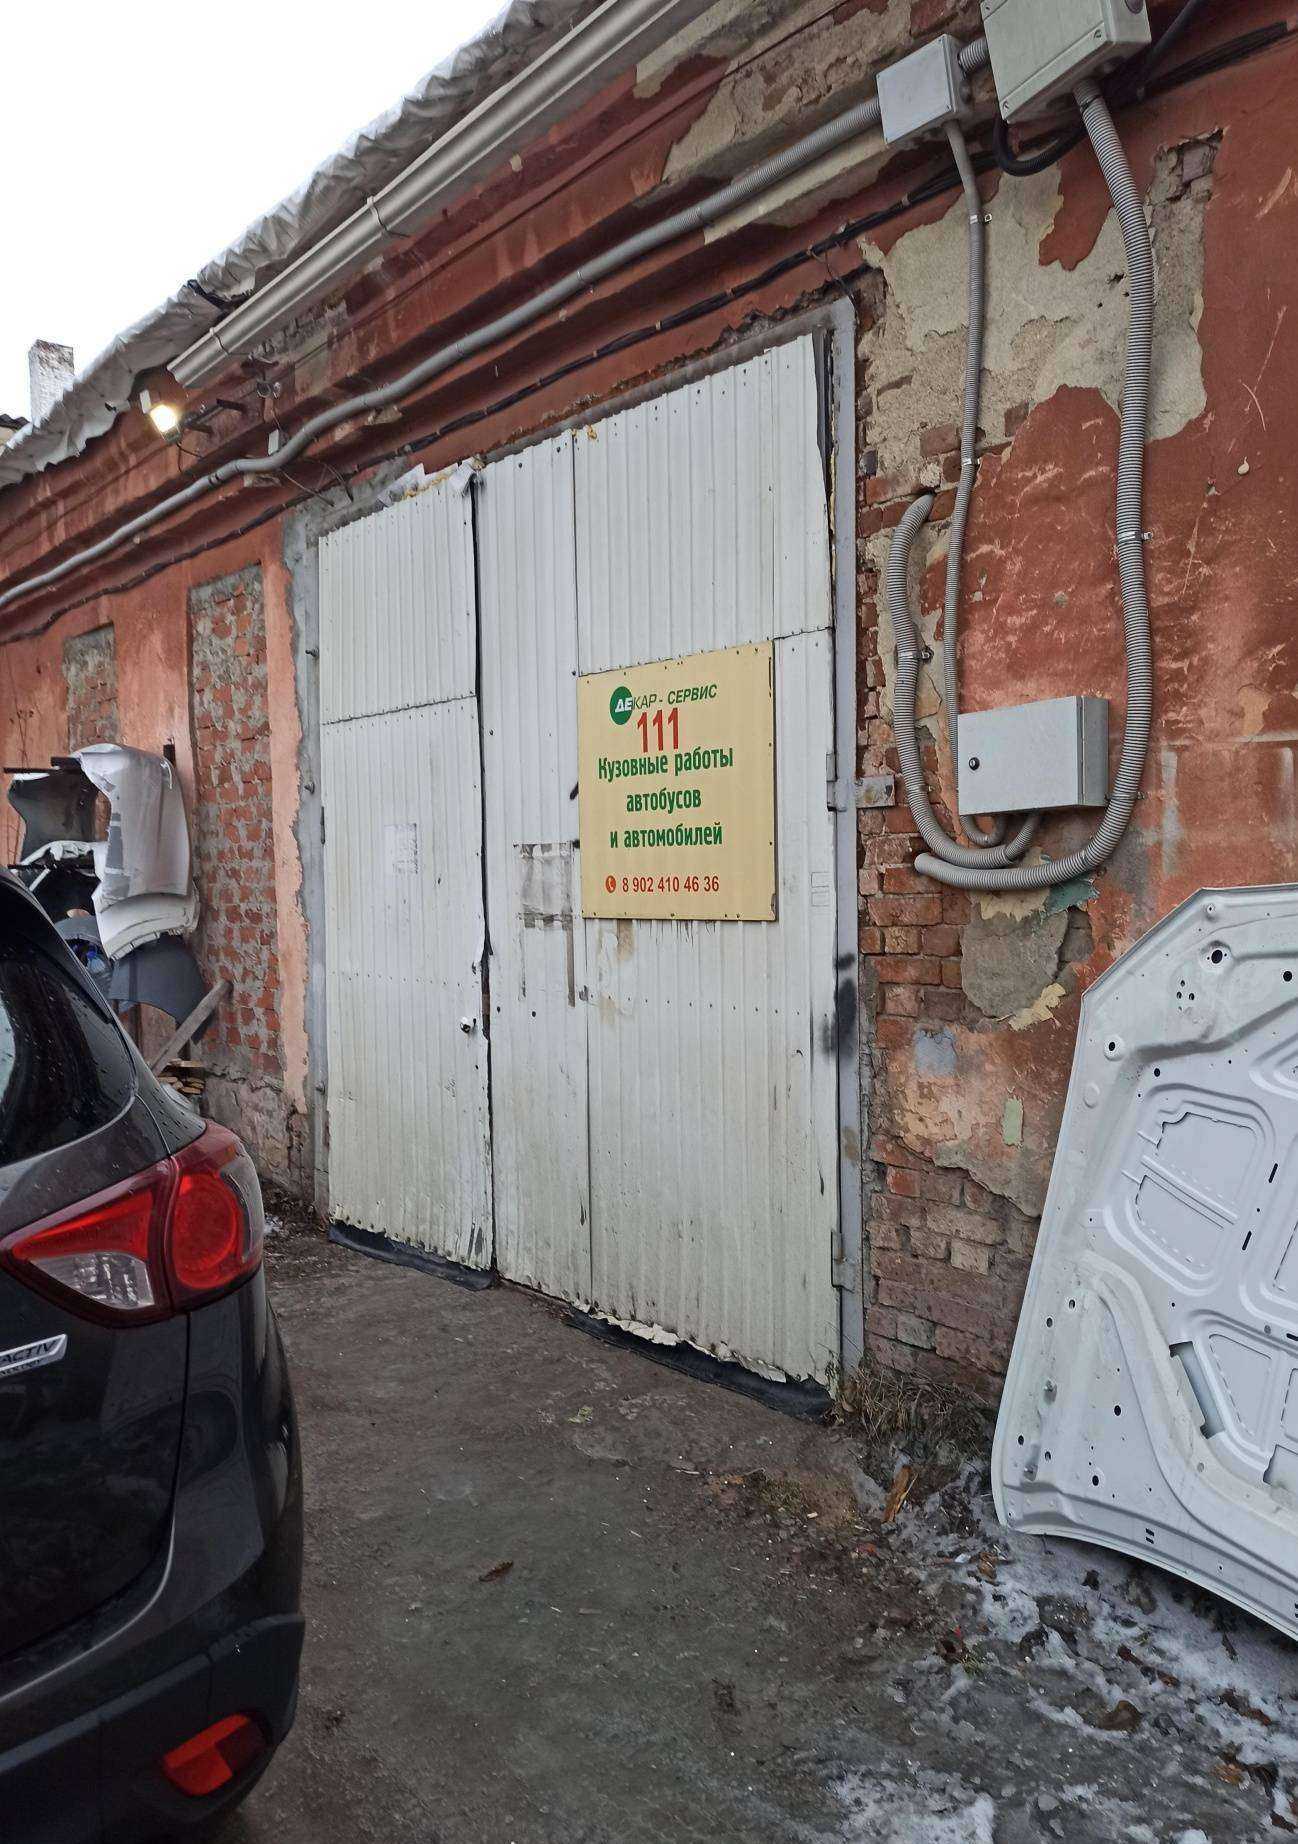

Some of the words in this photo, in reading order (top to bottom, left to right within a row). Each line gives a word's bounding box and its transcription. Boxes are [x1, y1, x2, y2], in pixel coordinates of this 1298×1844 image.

[667, 684, 718, 705] СЕРВИС
[637, 708, 679, 753] 111
[598, 755, 668, 783] Кузовные
[675, 747, 734, 776] работы
[626, 788, 702, 814] автобусов
[610, 831, 618, 848] и
[624, 822, 723, 848] автомобилей
[622, 877, 629, 892] 8
[632, 877, 654, 892] 902
[658, 877, 680, 892] 410
[684, 876, 700, 892] 46
[703, 876, 719, 892] 36
